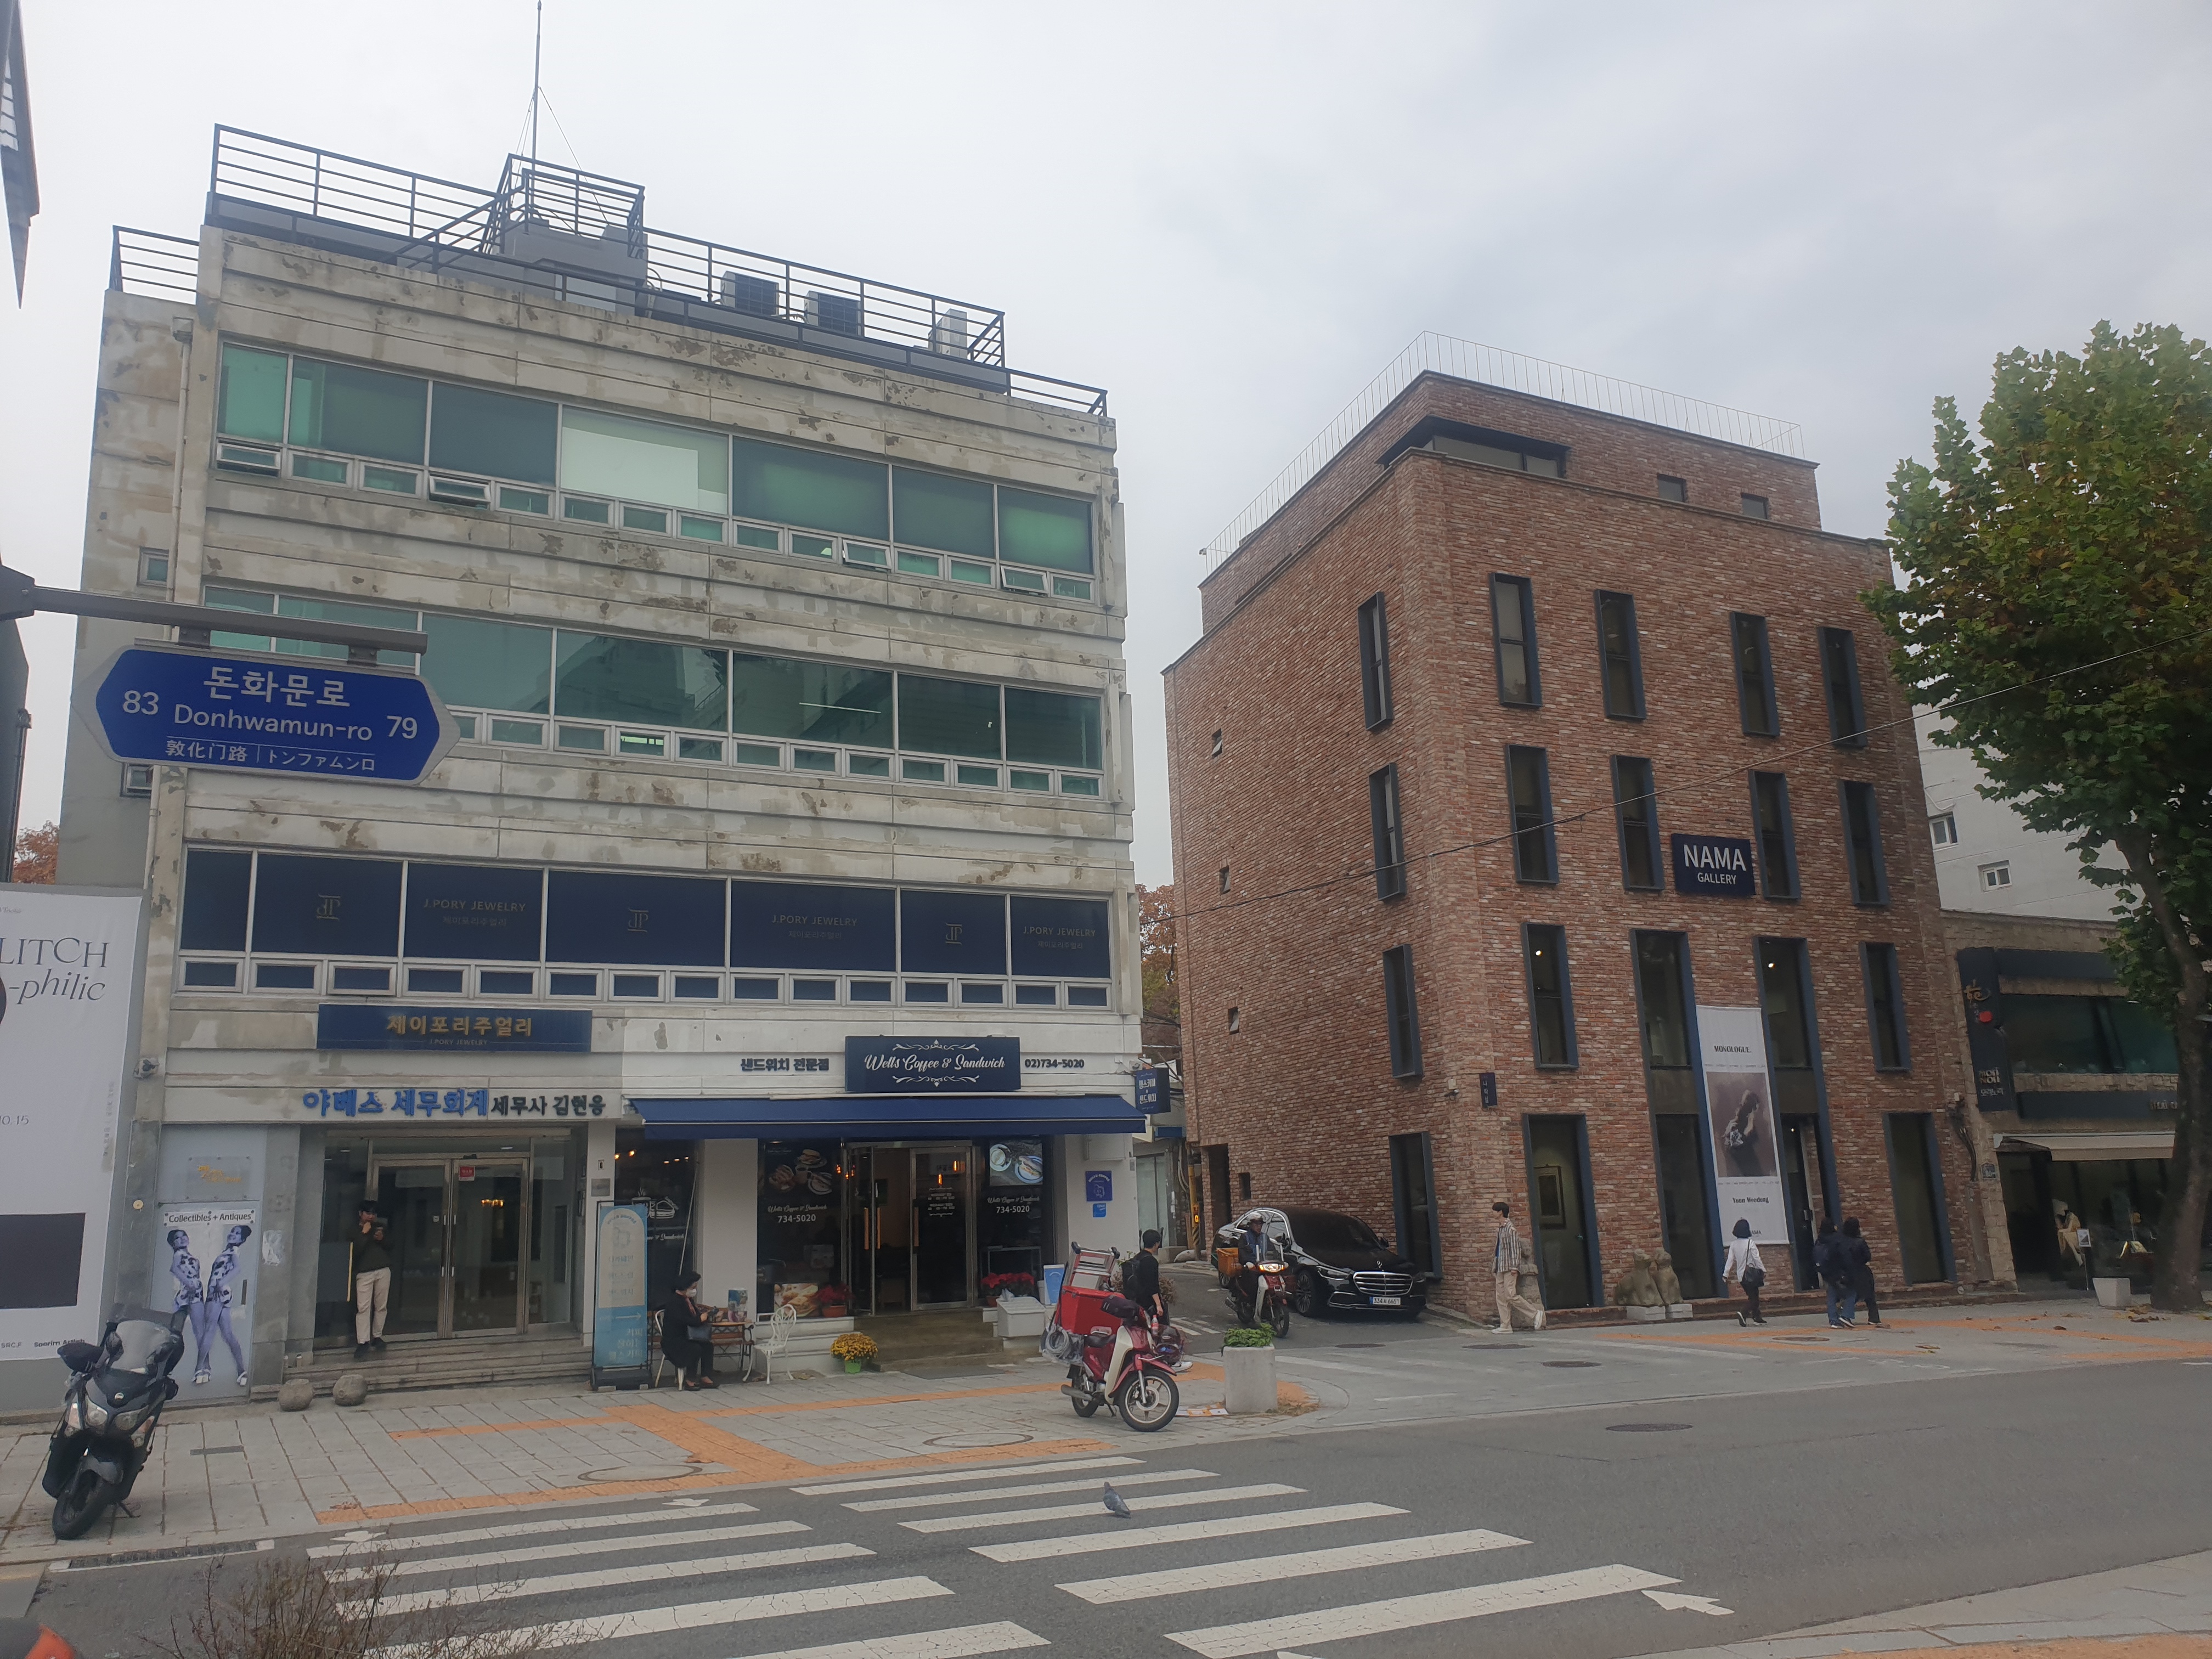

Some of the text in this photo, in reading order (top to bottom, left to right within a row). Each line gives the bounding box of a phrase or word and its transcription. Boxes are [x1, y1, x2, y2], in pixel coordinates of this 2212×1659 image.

[204, 666, 350, 708] 돈화문로
[122, 690, 159, 715] 83
[174, 704, 372, 741] Donhwamun-ro
[386, 715, 417, 739] 79
[166, 740, 248, 763] 敦化门路
[268, 749, 375, 771] トンファムンロ
[1683, 844, 1747, 871] NAMA
[1697, 872, 1736, 884] GALLERY
[424, 898, 526, 912] J.PORY JEWELRY
[771, 915, 857, 927] J.PORY JEWELRY
[1023, 926, 1096, 937] J.PORY JEWELRY
[387, 1015, 532, 1037] 제이포리주얼리
[741, 1058, 830, 1071] 샌드위치 전문점
[864, 1054, 1006, 1073] Wells Coffee & Sandwich
[1024, 1058, 1085, 1069] 02)734-5020
[303, 1088, 383, 1117] 야베스
[391, 1088, 488, 1117] 세무회계
[491, 1095, 548, 1116] 세무사
[168, 1214, 211, 1223] Collectibles
[219, 1212, 252, 1222] Antiques
[777, 1214, 816, 1223] 734-5020
